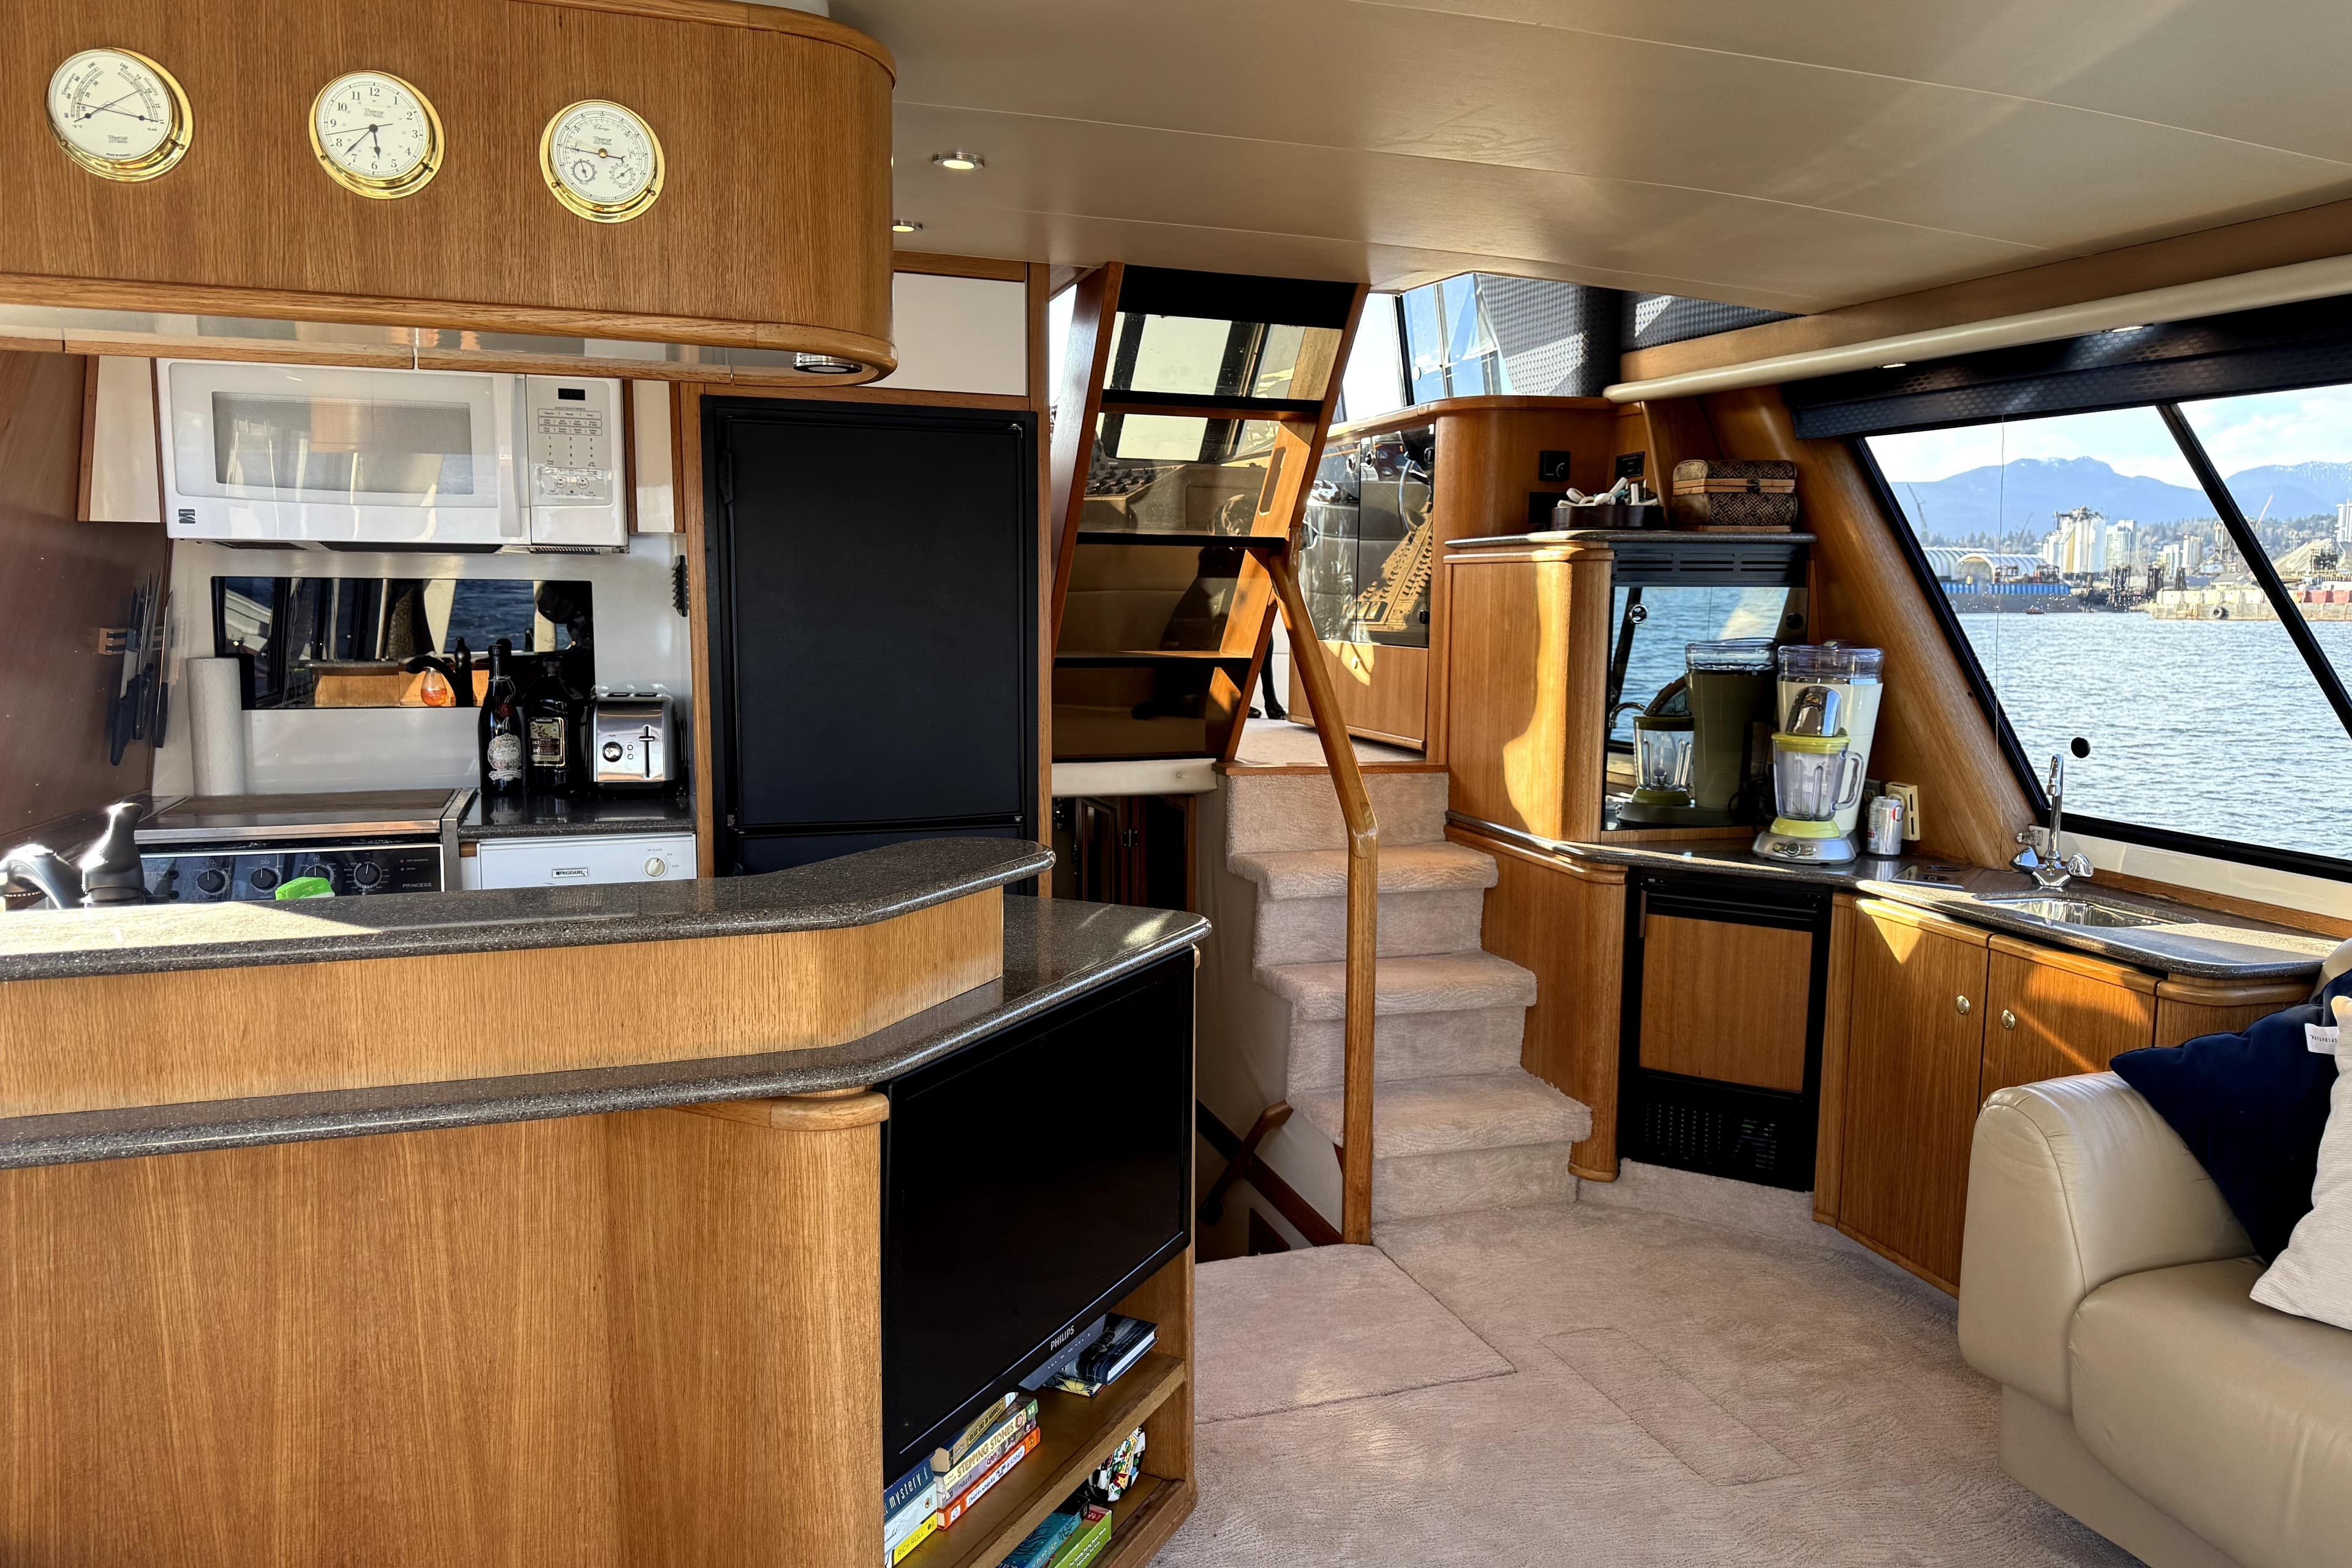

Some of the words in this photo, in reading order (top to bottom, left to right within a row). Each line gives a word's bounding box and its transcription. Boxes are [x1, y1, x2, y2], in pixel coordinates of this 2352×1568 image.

[352, 91, 360, 100] 11
[369, 87, 380, 97] 12
[394, 96, 398, 105] 1
[337, 102, 347, 111] 10
[406, 111, 412, 120] 2
[330, 119, 336, 127] 9
[412, 129, 418, 138] 3
[336, 138, 342, 147] 8
[405, 147, 412, 156] 4
[352, 153, 357, 162] 7
[371, 161, 377, 170] 6
[391, 159, 397, 168] 5
[1050, 1325, 1074, 1351] PHILIPS
[957, 1442, 989, 1477] STEPPING
[990, 1422, 1015, 1450] STONES
[889, 1472, 922, 1509] mystery
[911, 1529, 925, 1546] ROLL
